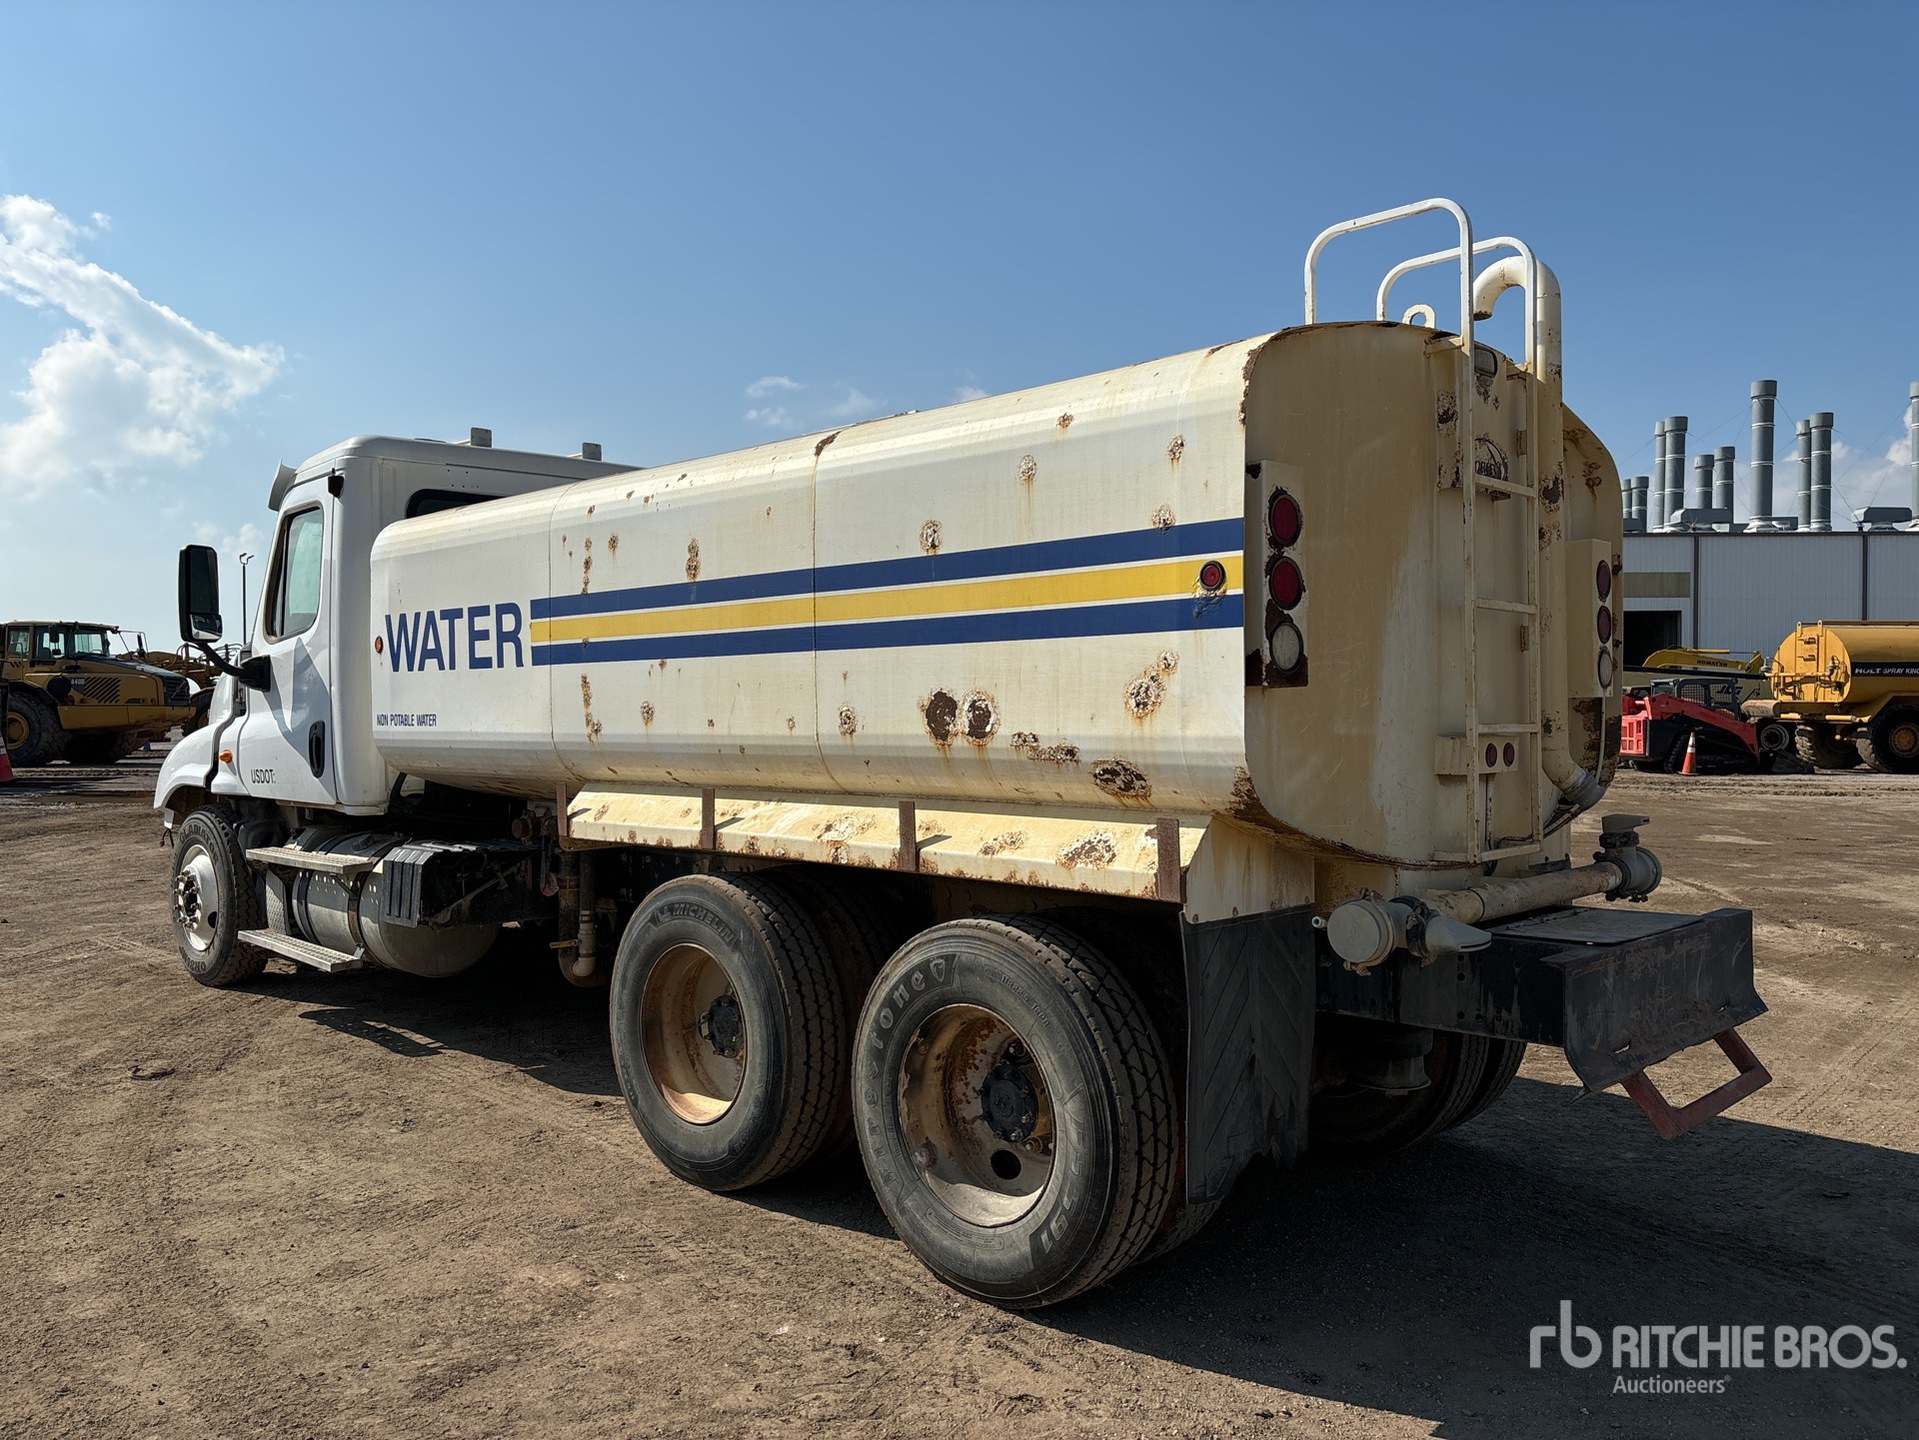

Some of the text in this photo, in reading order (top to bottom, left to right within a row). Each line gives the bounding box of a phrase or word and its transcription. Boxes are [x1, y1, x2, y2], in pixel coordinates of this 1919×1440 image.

[385, 602, 524, 672] WATER
[1697, 659, 1728, 667] KOMATSU
[377, 714, 437, 726] NON POTABLE WATER
[251, 769, 276, 784] USDOT:
[180, 823, 218, 866] GLADIATOR
[673, 903, 734, 942] MICHELIN
